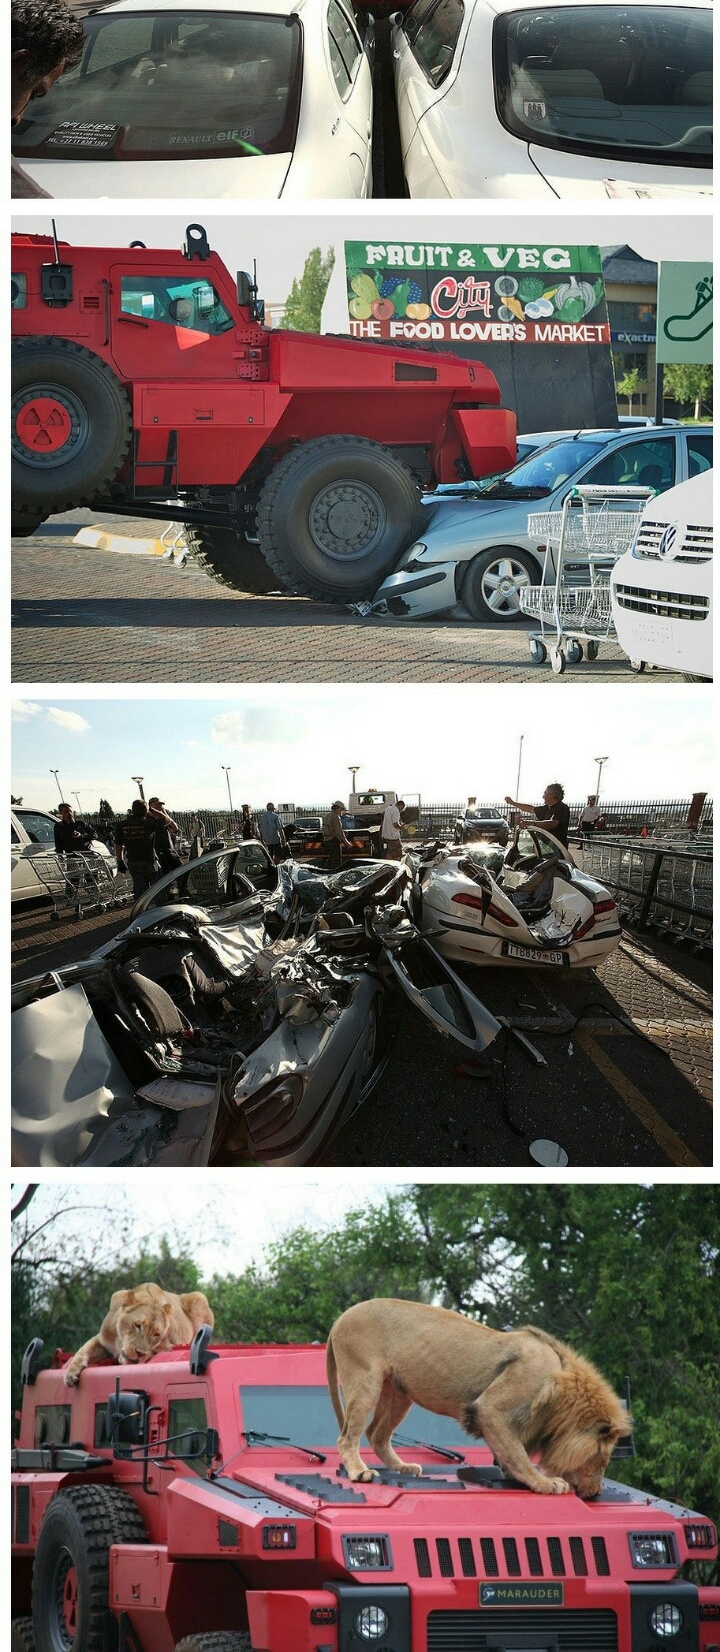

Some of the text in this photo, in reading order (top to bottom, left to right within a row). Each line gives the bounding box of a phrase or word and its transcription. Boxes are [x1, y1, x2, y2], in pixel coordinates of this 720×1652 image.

[216, 130, 240, 141] elf
[366, 244, 572, 269] FRUIT & VEG
[430, 275, 493, 319] City
[349, 320, 381, 338] THE
[390, 321, 445, 340] FOOD
[535, 324, 606, 343] MARKET
[497, 1589, 560, 1598] MARAUDER
